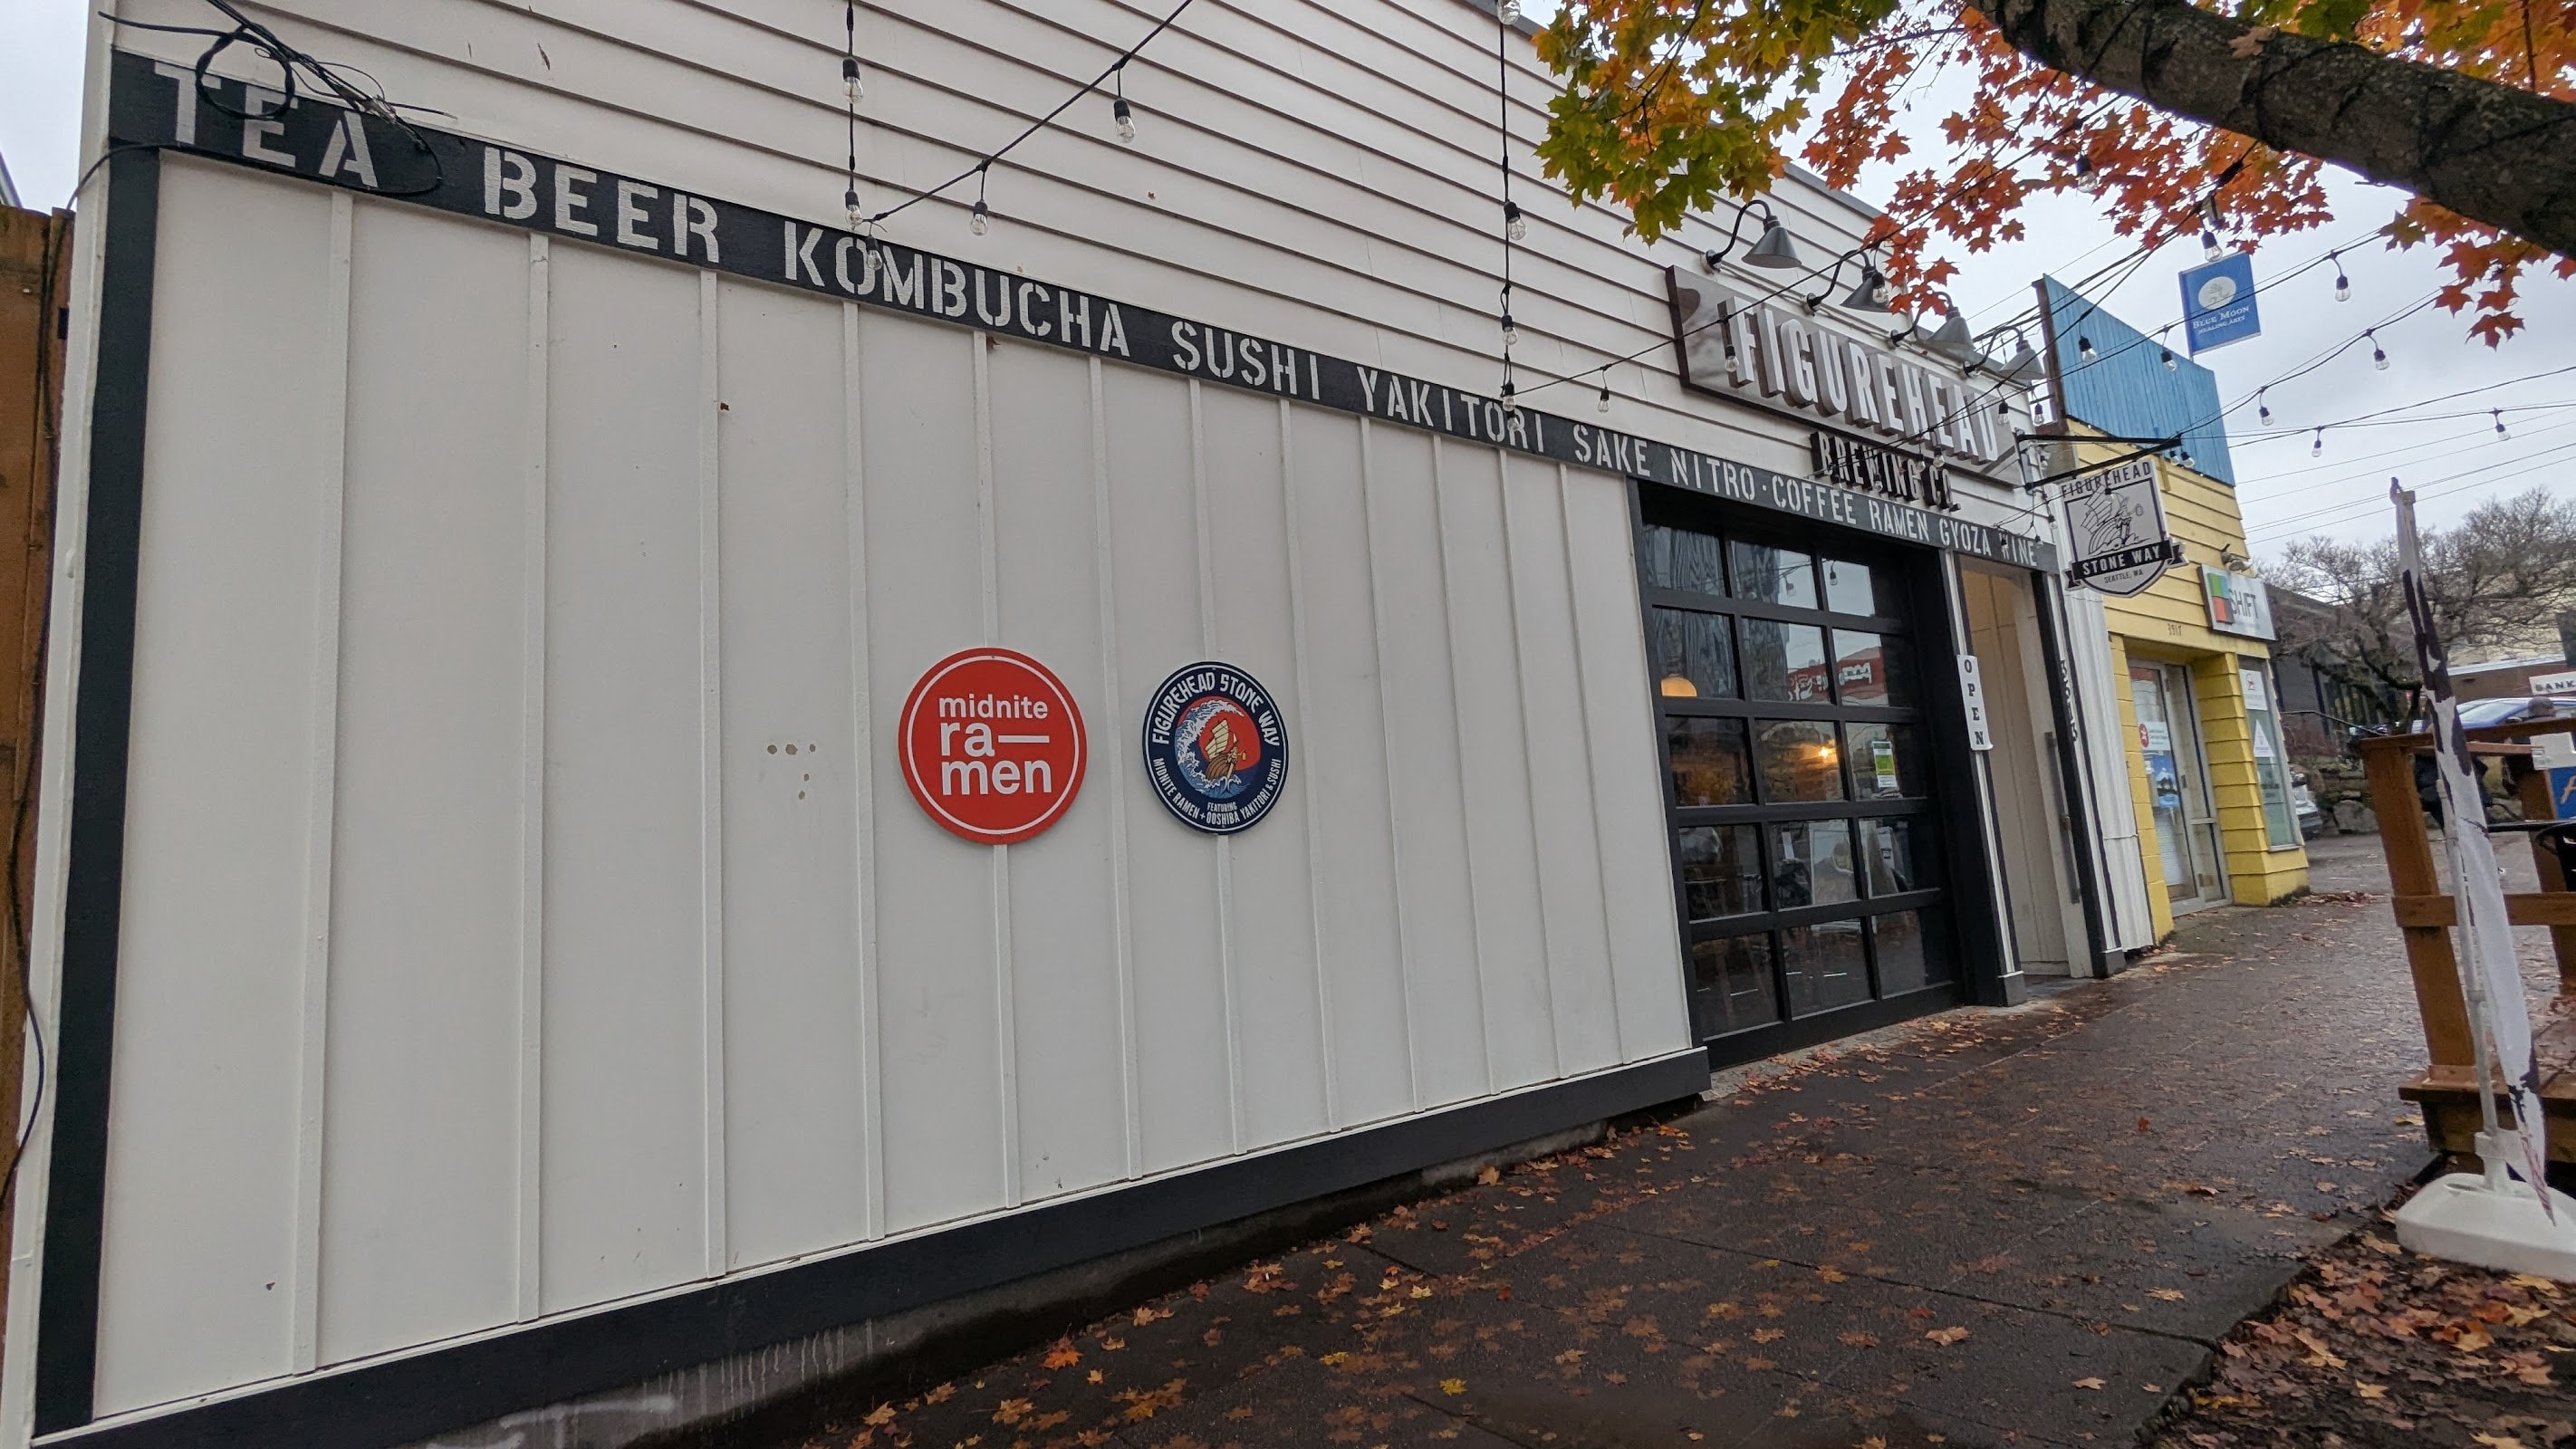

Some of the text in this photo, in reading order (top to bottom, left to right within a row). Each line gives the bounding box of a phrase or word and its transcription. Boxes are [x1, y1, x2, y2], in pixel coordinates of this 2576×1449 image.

[154, 60, 379, 189] TEA
[483, 146, 720, 264] BEER
[783, 220, 1130, 357] KOMBUCHA
[1171, 320, 1321, 400] SUSHI
[1356, 366, 1544, 453] YAKITORI
[1572, 424, 1651, 477] SAKE
[1868, 499, 1930, 542] RAMEN
[1938, 517, 1992, 557] GYOZA
[2193, 306, 2250, 329] BLUE MOON
[1721, 295, 1998, 465] FIGUREHEAD
[1814, 431, 1921, 500] BREWING
[2062, 461, 2151, 498] FIGUREHEAD
[2082, 545, 2160, 575] STONE WAY
[2133, 569, 2144, 577] WA
[2228, 588, 2259, 619] SHIFT
[938, 694, 1048, 719] midnite
[1151, 672, 1280, 746] FIGUREHEAD STONE WAY
[1964, 658, 1985, 745] OPEN
[941, 759, 1053, 795] men
[1153, 757, 1177, 797] MIDNITE
[1172, 792, 1201, 820] RAMEN
[1206, 811, 1241, 825] OOSHIBA
[1240, 790, 1271, 820] YAKITORI
[1267, 758, 1282, 785] SUSHI
[1206, 801, 1238, 812] FEATURING
